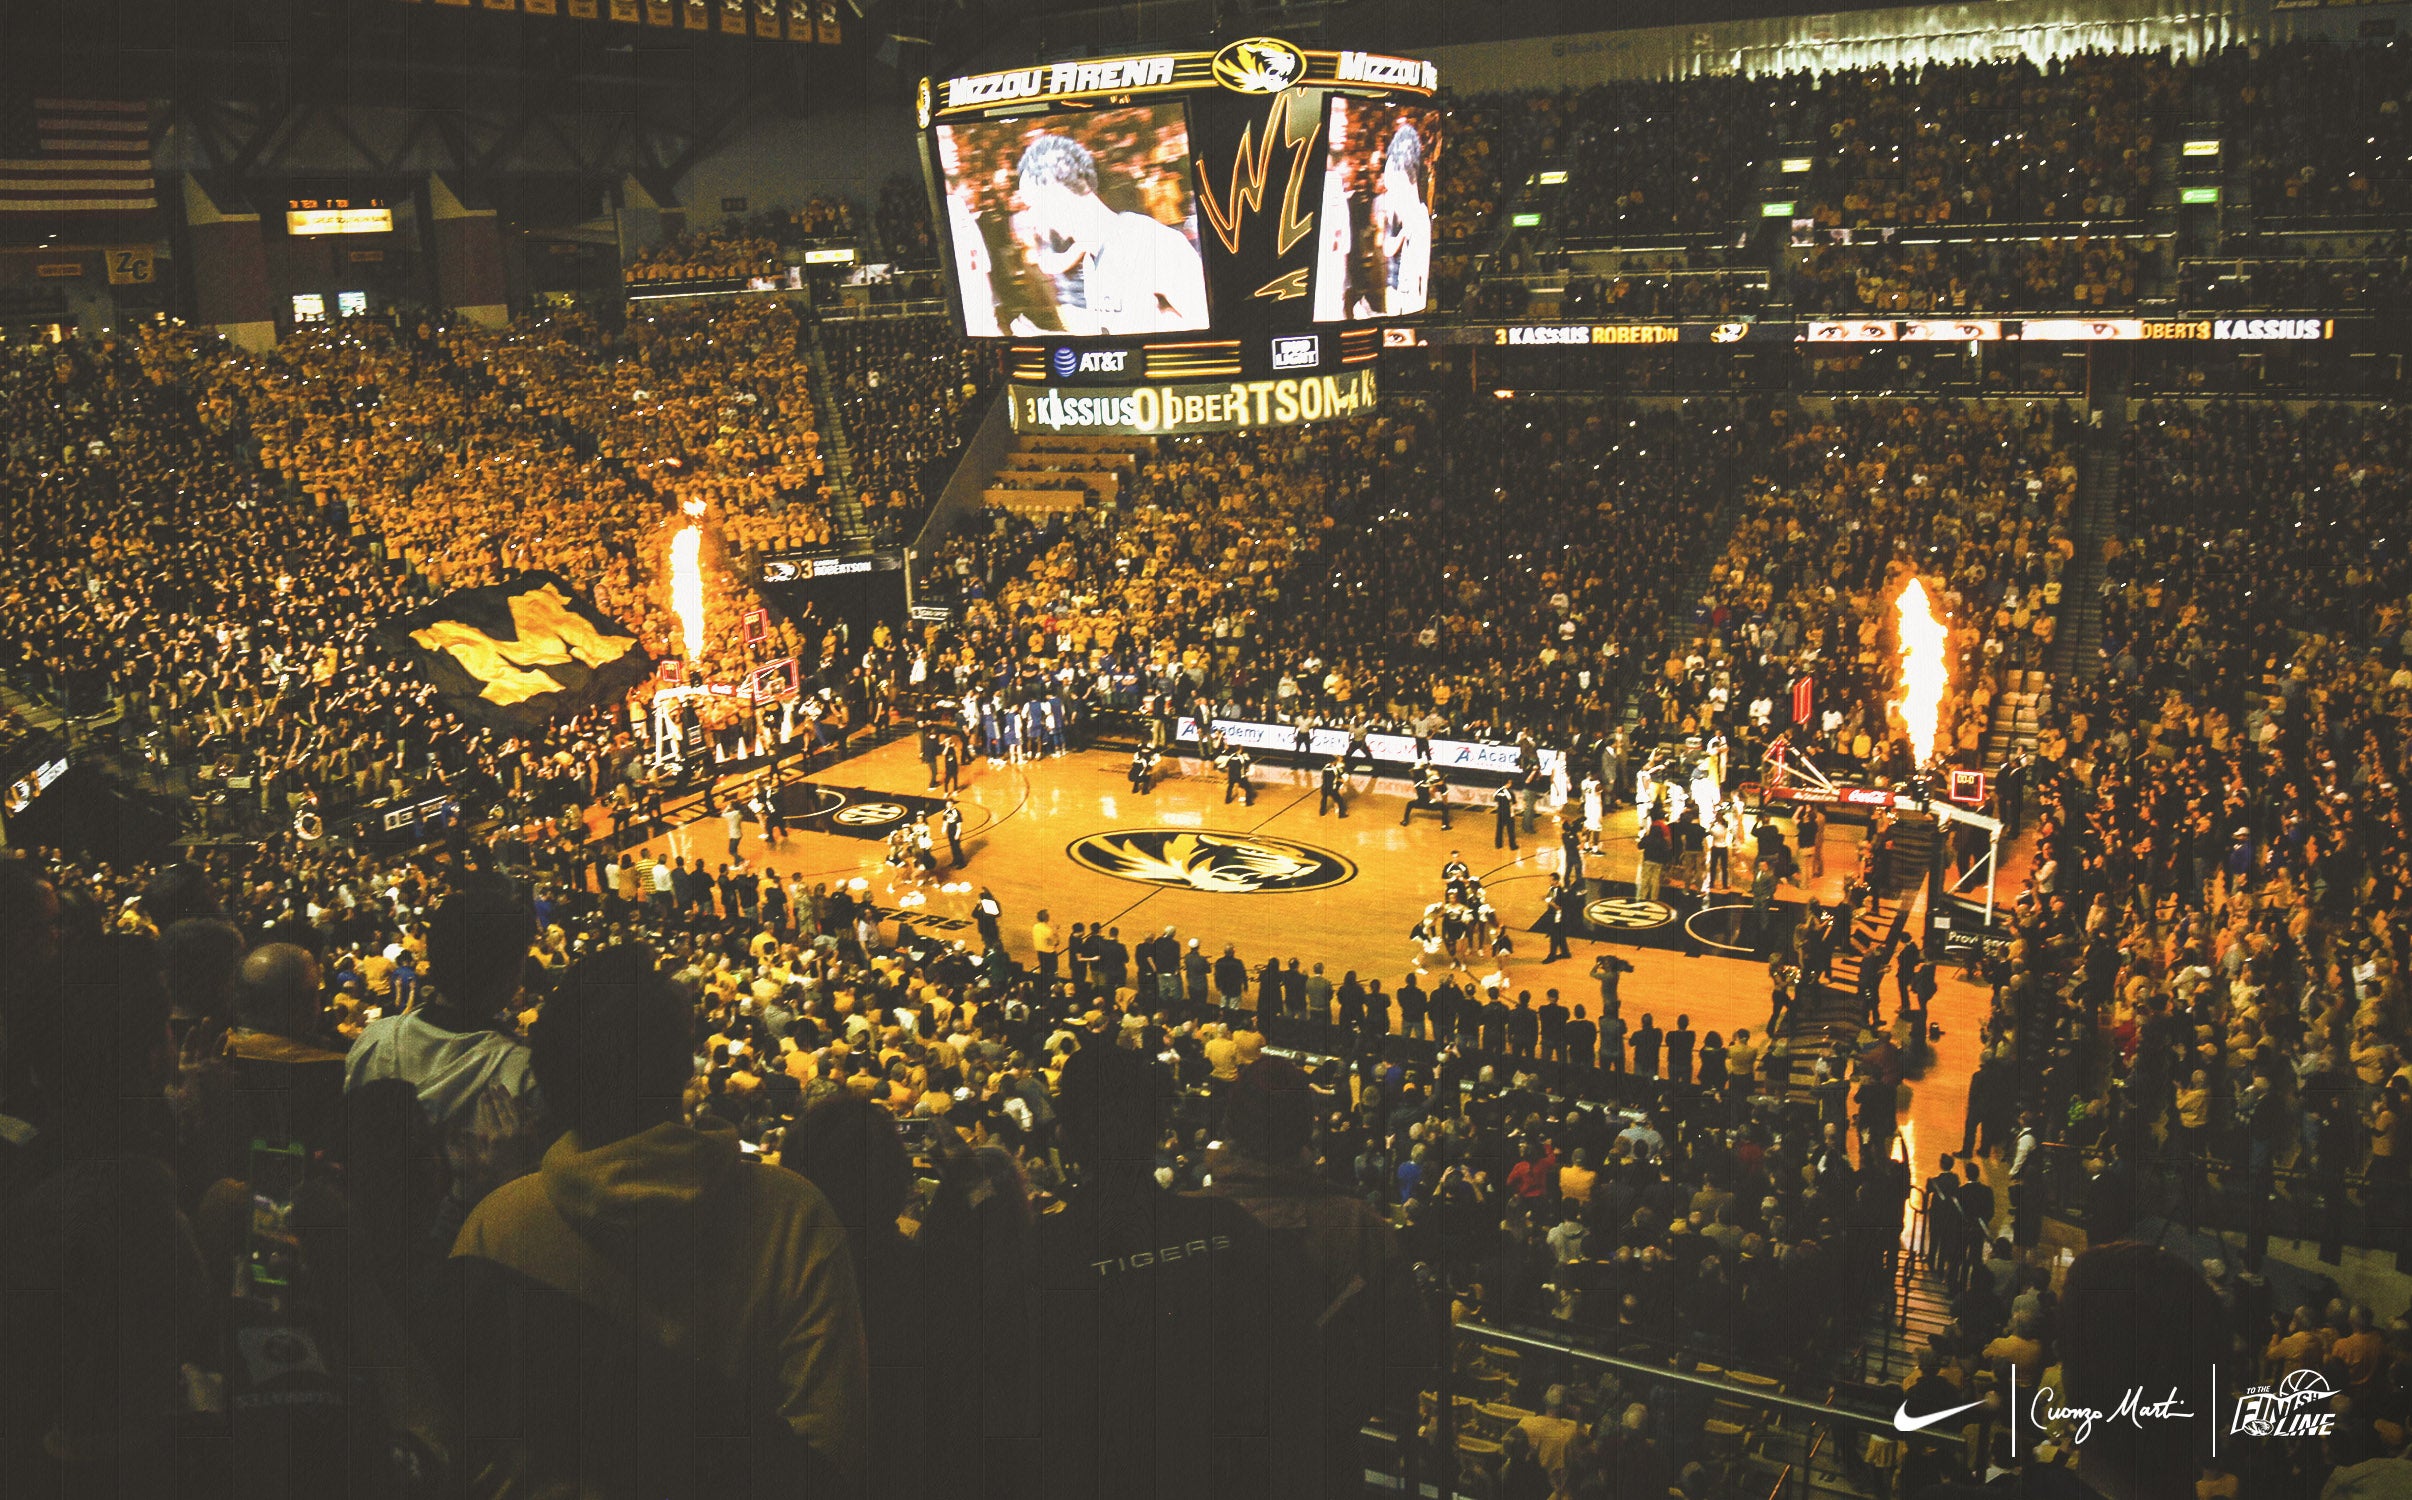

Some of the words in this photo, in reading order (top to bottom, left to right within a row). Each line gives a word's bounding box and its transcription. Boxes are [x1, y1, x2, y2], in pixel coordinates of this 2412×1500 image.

[1338, 51, 1420, 87] MIZZOU
[949, 70, 1043, 107] MIZZOU
[1050, 58, 1175, 94] ARENA
[1495, 328, 1508, 345] 3
[2213, 319, 2321, 340] KASSIUS
[1079, 351, 1128, 373] AT&T
[1026, 397, 1037, 424] 3
[801, 559, 815, 579] 3
[1090, 1235, 1231, 1277] TIGERS
